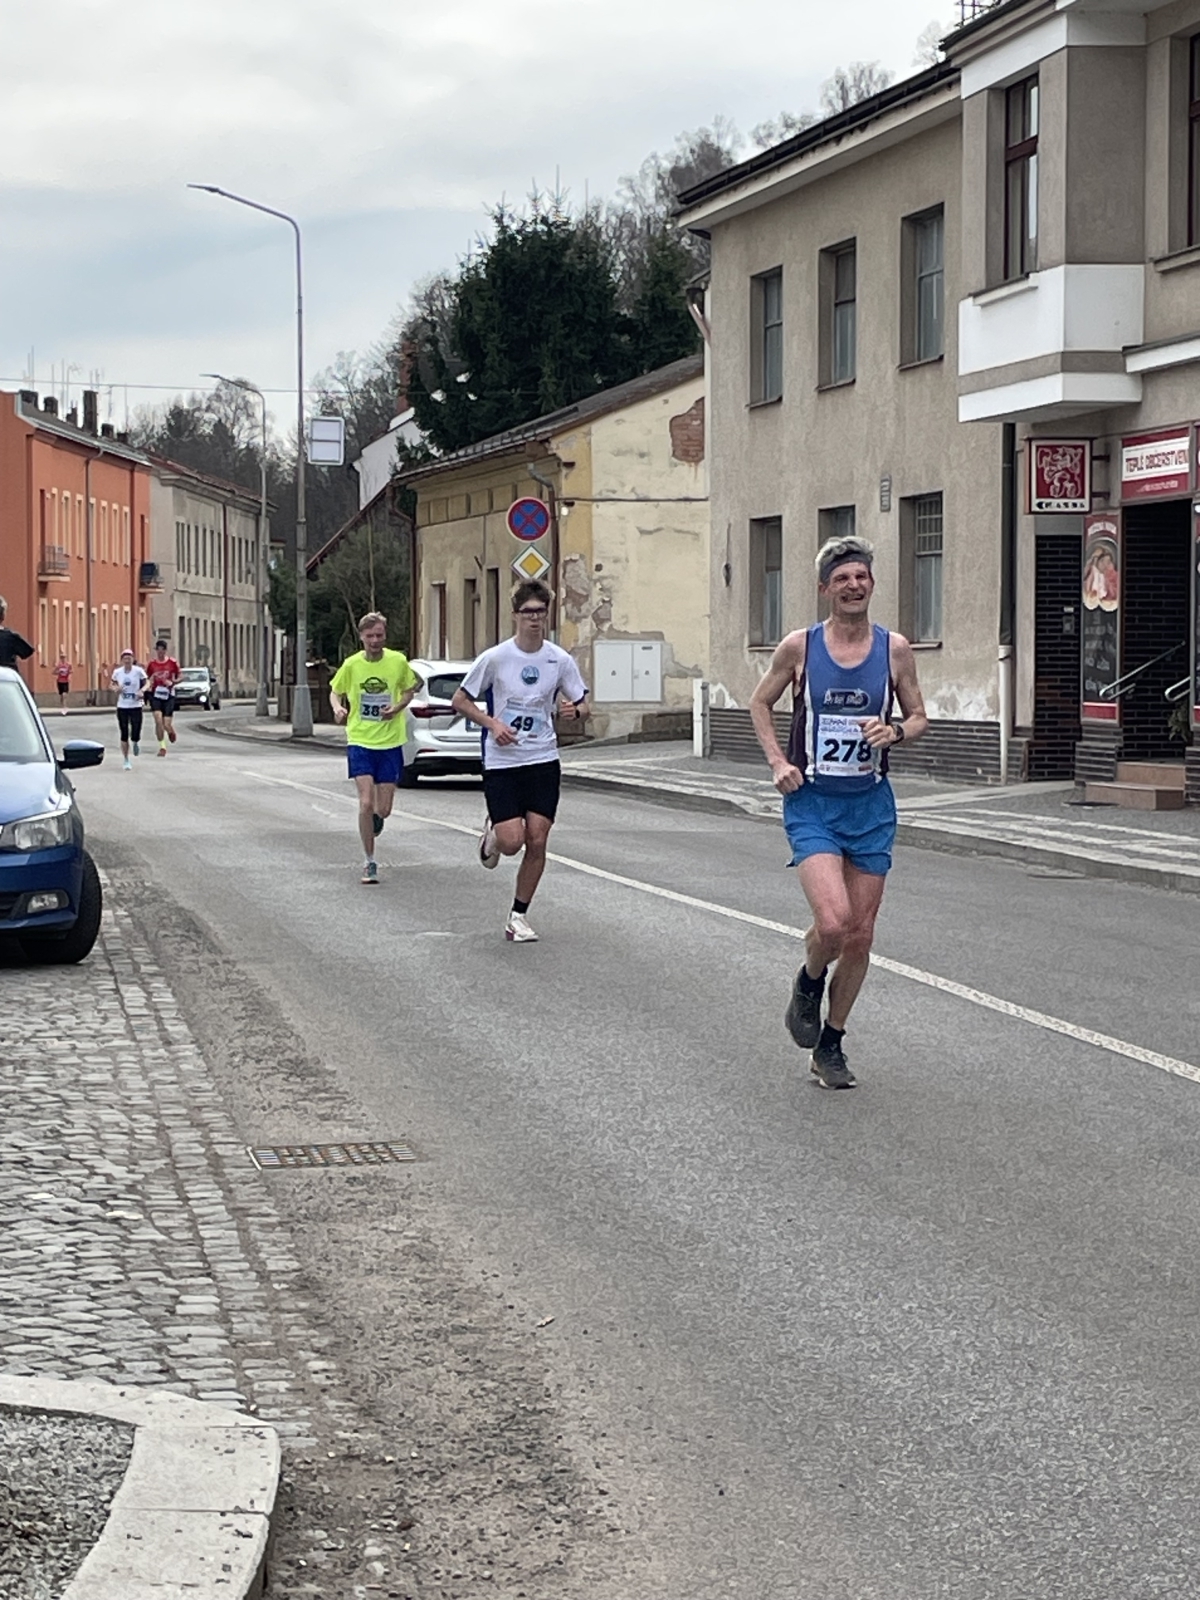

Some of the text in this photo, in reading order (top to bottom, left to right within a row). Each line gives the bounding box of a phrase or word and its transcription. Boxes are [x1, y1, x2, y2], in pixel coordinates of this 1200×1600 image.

[362, 704, 387, 716] 38
[510, 716, 534, 732] 49
[823, 738, 871, 762] 278
